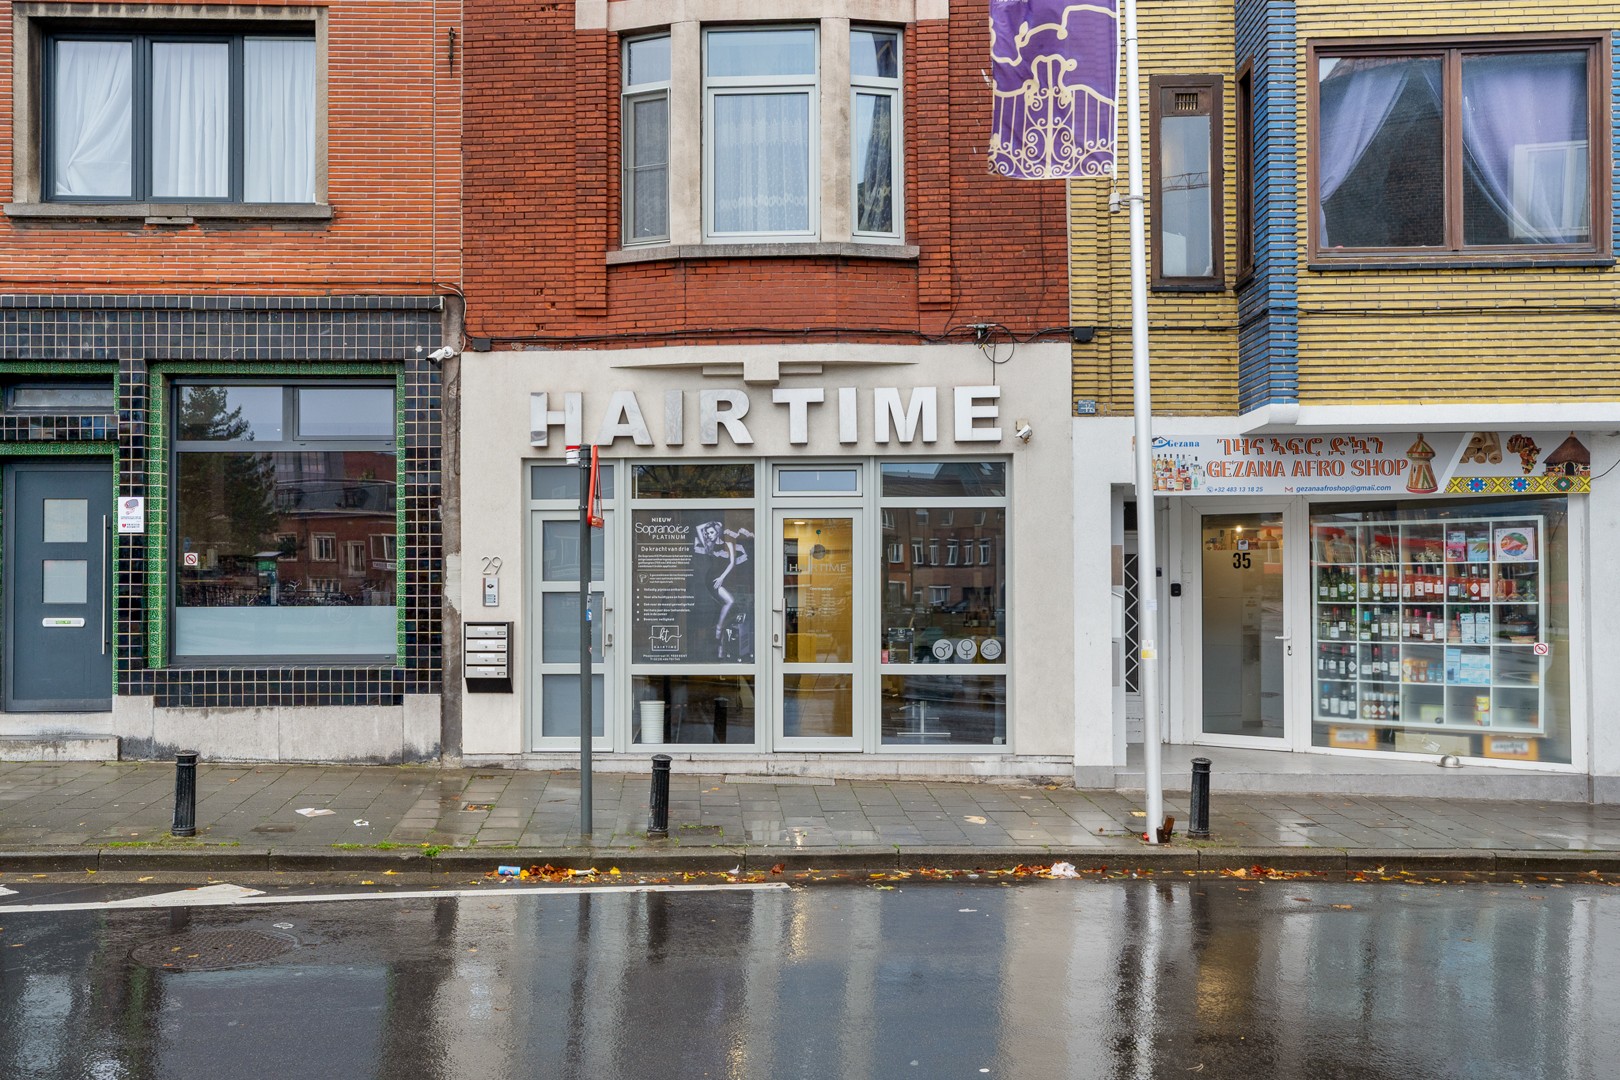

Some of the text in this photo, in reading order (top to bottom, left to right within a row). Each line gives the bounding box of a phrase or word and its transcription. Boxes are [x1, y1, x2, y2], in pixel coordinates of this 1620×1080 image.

[1167, 439, 1200, 448] Gezana
[1206, 458, 1408, 478] GEZANA AFRO SHOP
[481, 556, 503, 575] 29
[1233, 552, 1251, 569] 35
